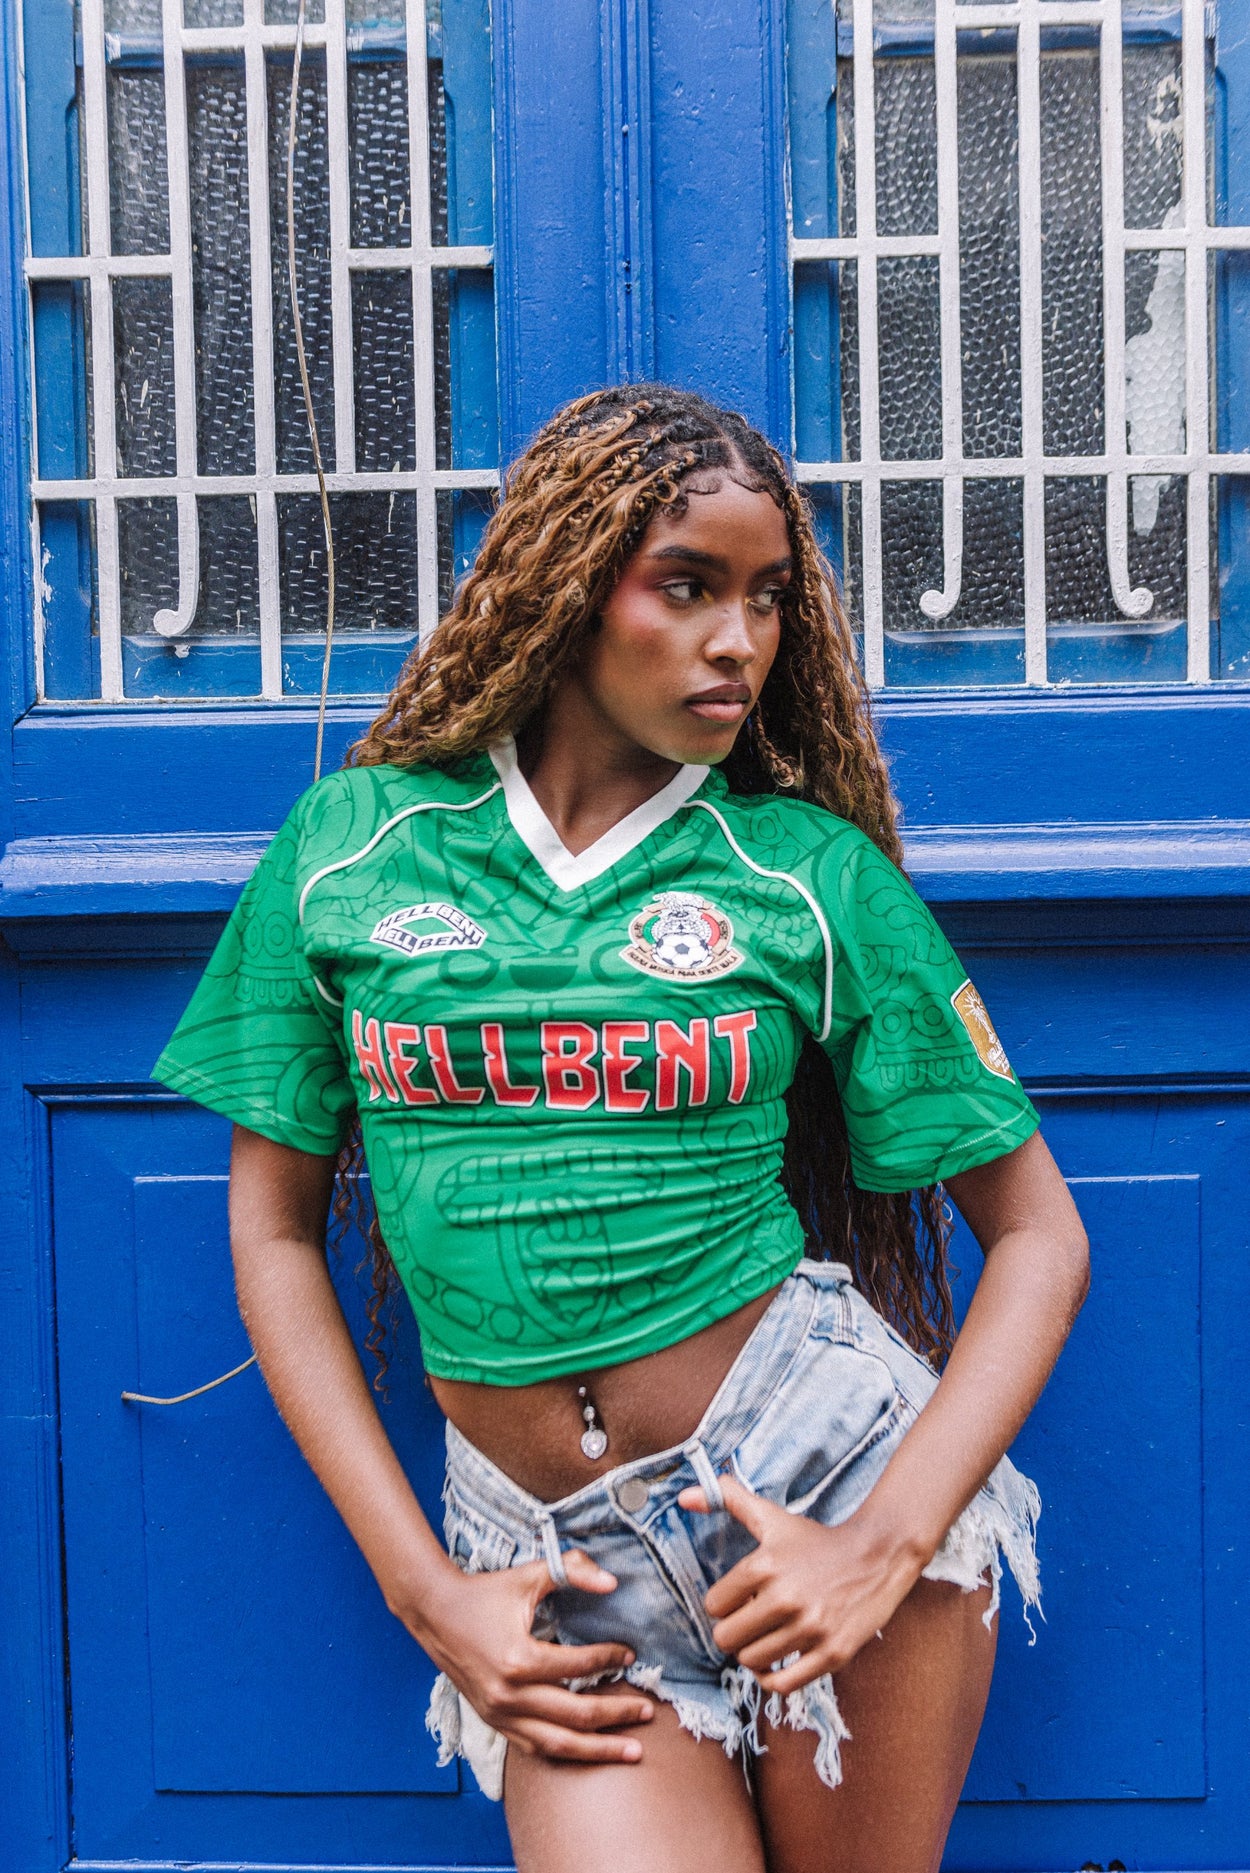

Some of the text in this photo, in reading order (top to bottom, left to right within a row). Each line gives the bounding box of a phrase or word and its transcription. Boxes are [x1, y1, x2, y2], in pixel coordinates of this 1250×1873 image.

[377, 904, 485, 946] HELL BENT
[352, 1009, 757, 1112] HELLBENT
